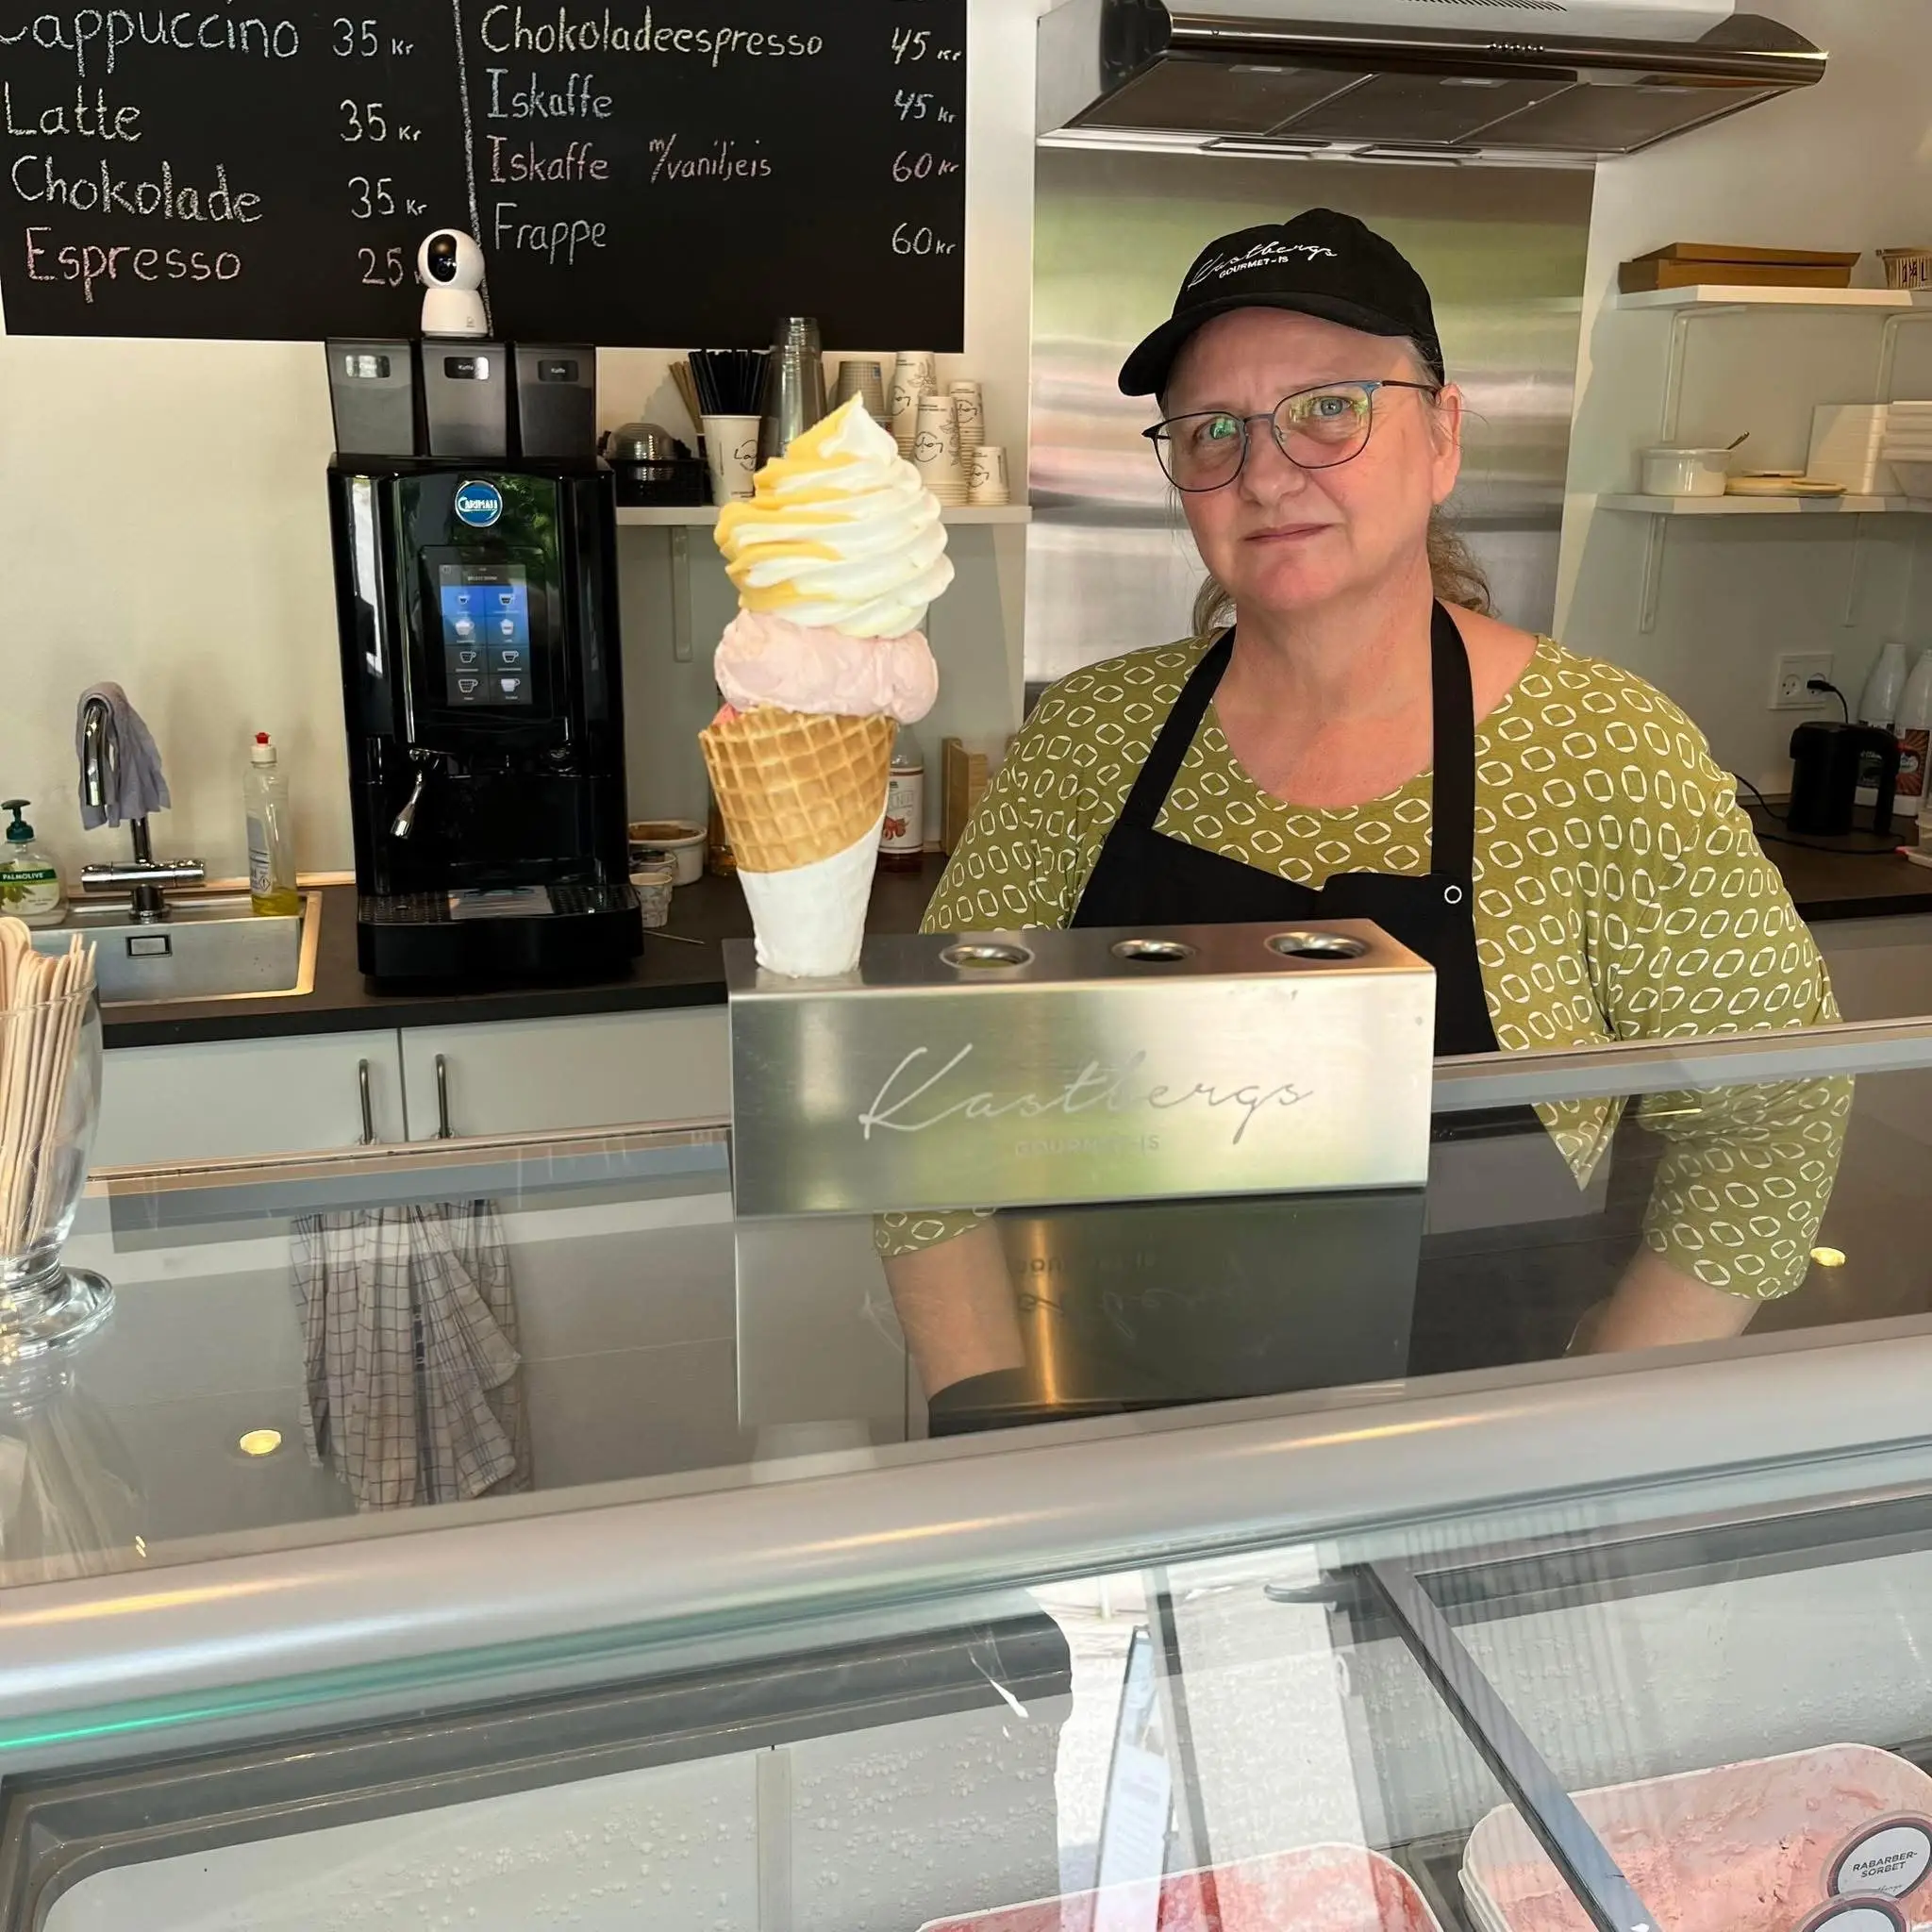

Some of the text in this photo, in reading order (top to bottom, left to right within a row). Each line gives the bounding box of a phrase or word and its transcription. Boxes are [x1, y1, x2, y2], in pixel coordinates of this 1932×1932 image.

[332, 17, 378, 58] 35
[480, 5, 824, 68] Chokoladeespresso
[891, 26, 931, 65] 45
[4, 81, 142, 142] Latte
[340, 99, 387, 142] 35
[485, 68, 613, 119] Iskaffe
[893, 89, 934, 121] 45
[485, 134, 610, 183] Iskaffe
[891, 150, 933, 183] 60
[11, 155, 263, 224] Chokolade
[347, 175, 395, 219] 35
[494, 202, 607, 265] Frappe
[891, 222, 933, 255] 60
[25, 226, 242, 304] Espresso
[358, 247, 404, 287] 25
[2, 872, 44, 880] PALMOLIVE
[858, 1042, 1315, 1144] Kastbergs
[1852, 1851, 1918, 1873] RABARBER-
[1860, 1861, 1907, 1878] SORBET
